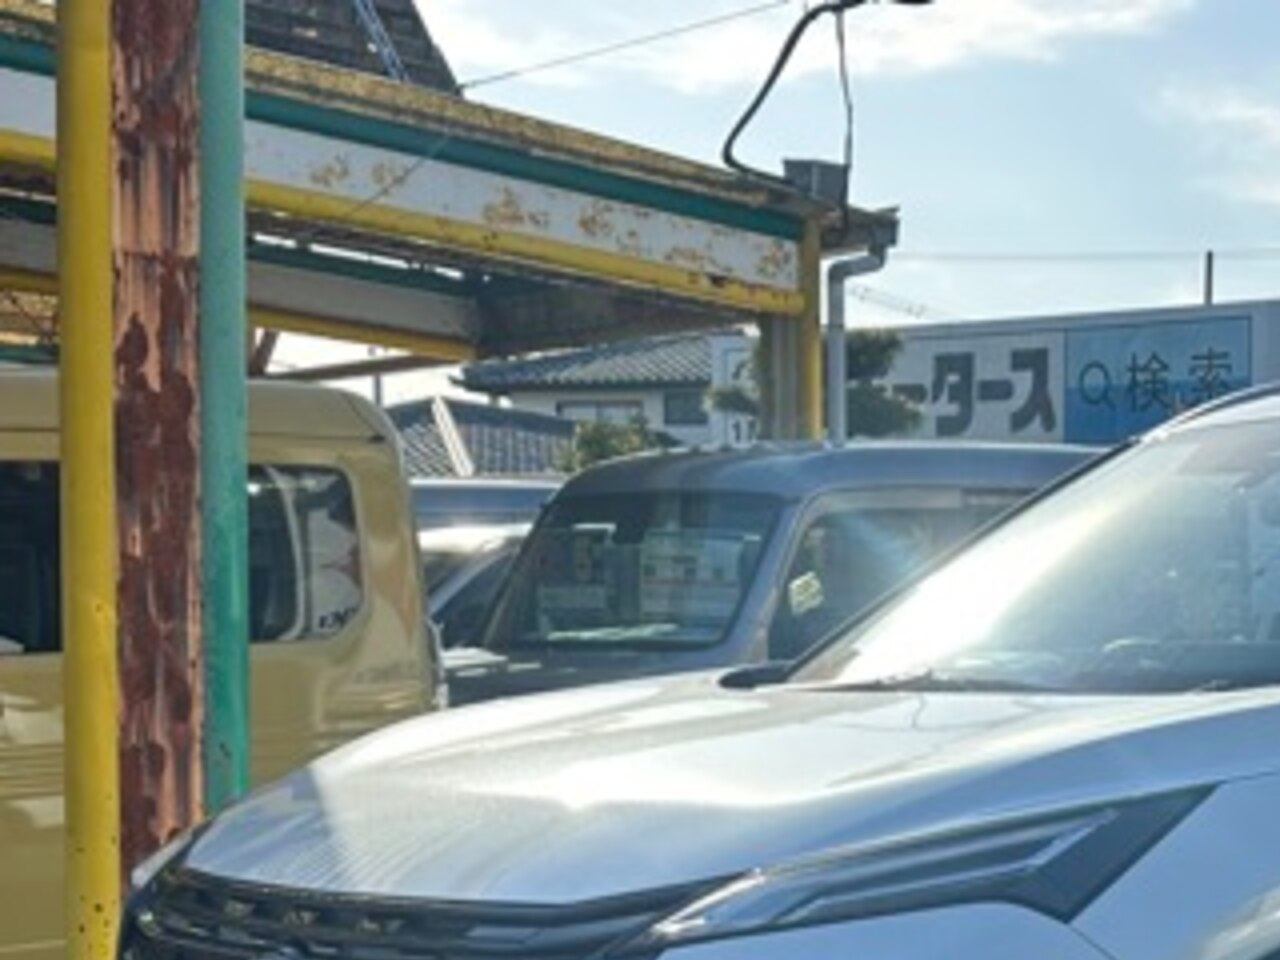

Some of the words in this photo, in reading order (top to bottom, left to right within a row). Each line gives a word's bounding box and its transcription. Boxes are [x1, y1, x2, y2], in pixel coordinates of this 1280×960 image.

[872, 347, 1056, 437] ータース
[1127, 345, 1234, 412] 検索
